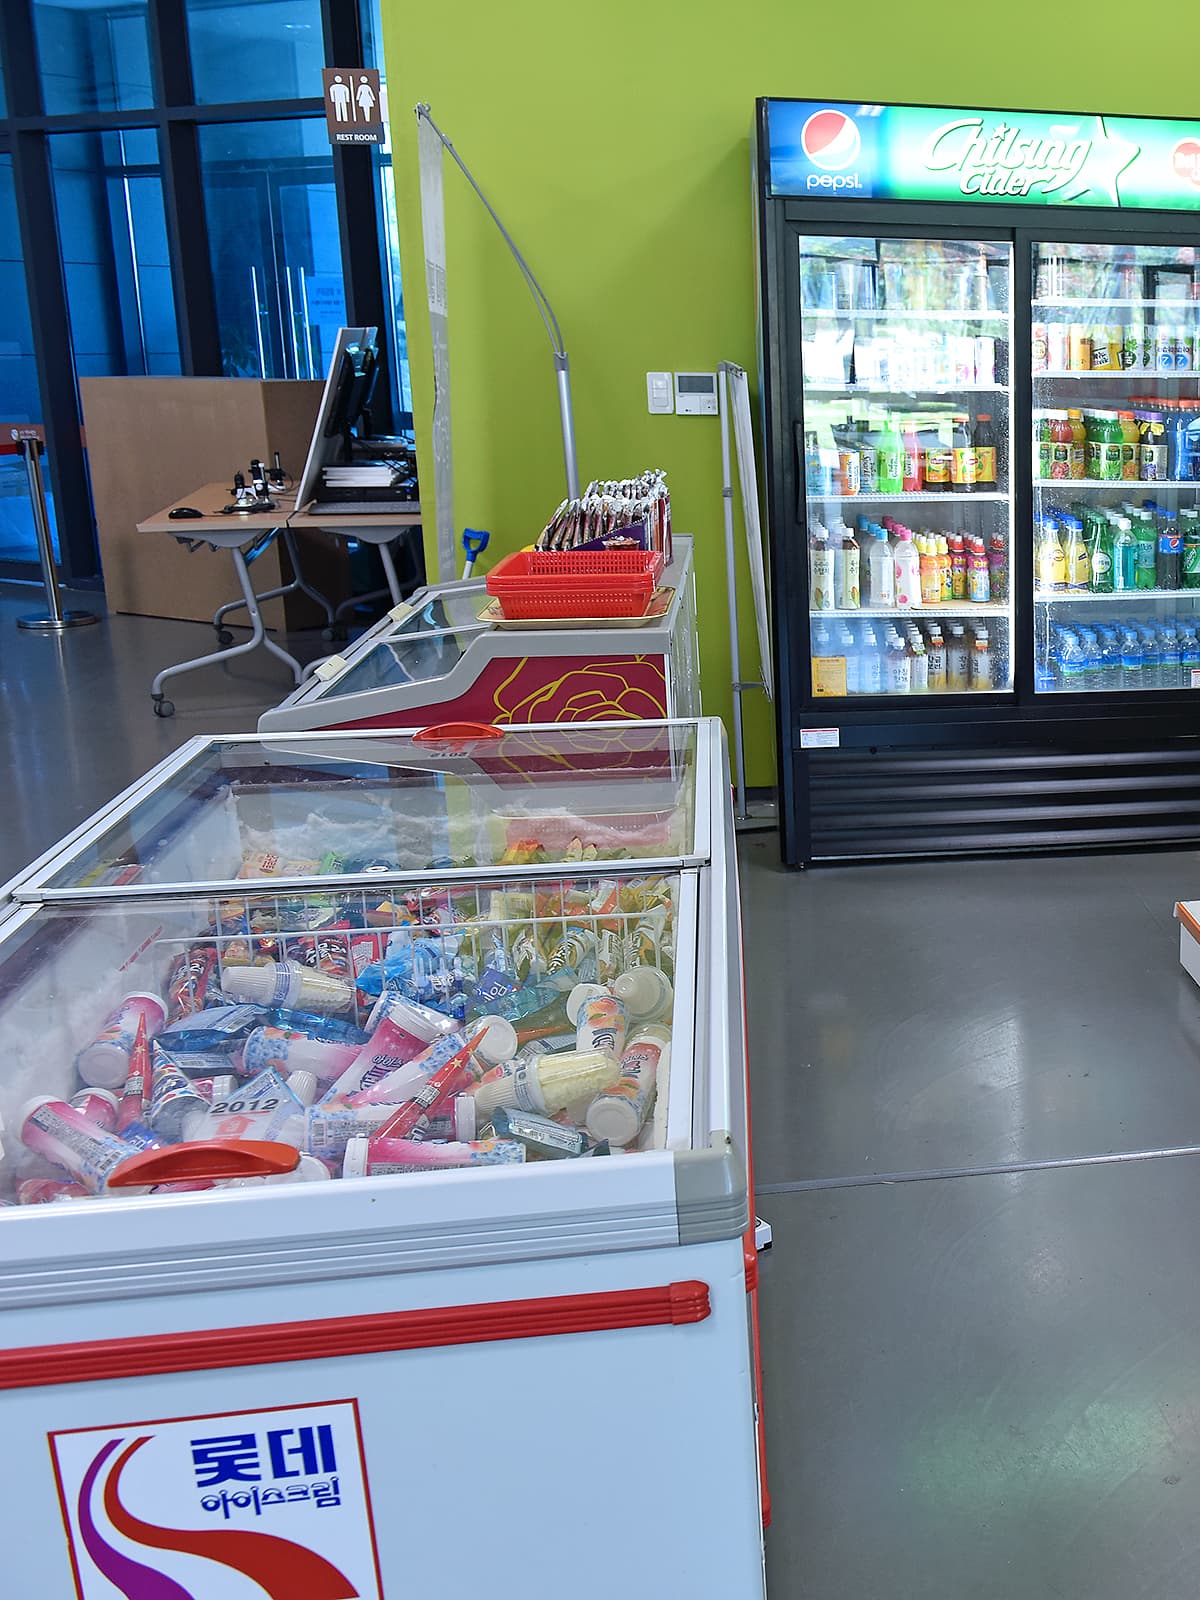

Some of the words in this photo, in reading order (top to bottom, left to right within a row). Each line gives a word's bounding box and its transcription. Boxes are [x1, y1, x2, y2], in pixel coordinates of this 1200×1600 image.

[336, 133, 353, 141] REST
[354, 134, 378, 142] ROOM
[924, 117, 1092, 184] Chilsung
[806, 173, 860, 191] pepsi
[959, 170, 1049, 197] Cider
[209, 1098, 278, 1118] 2012
[190, 1424, 337, 1488] 롯데
[200, 1476, 342, 1519] 아이스크림
